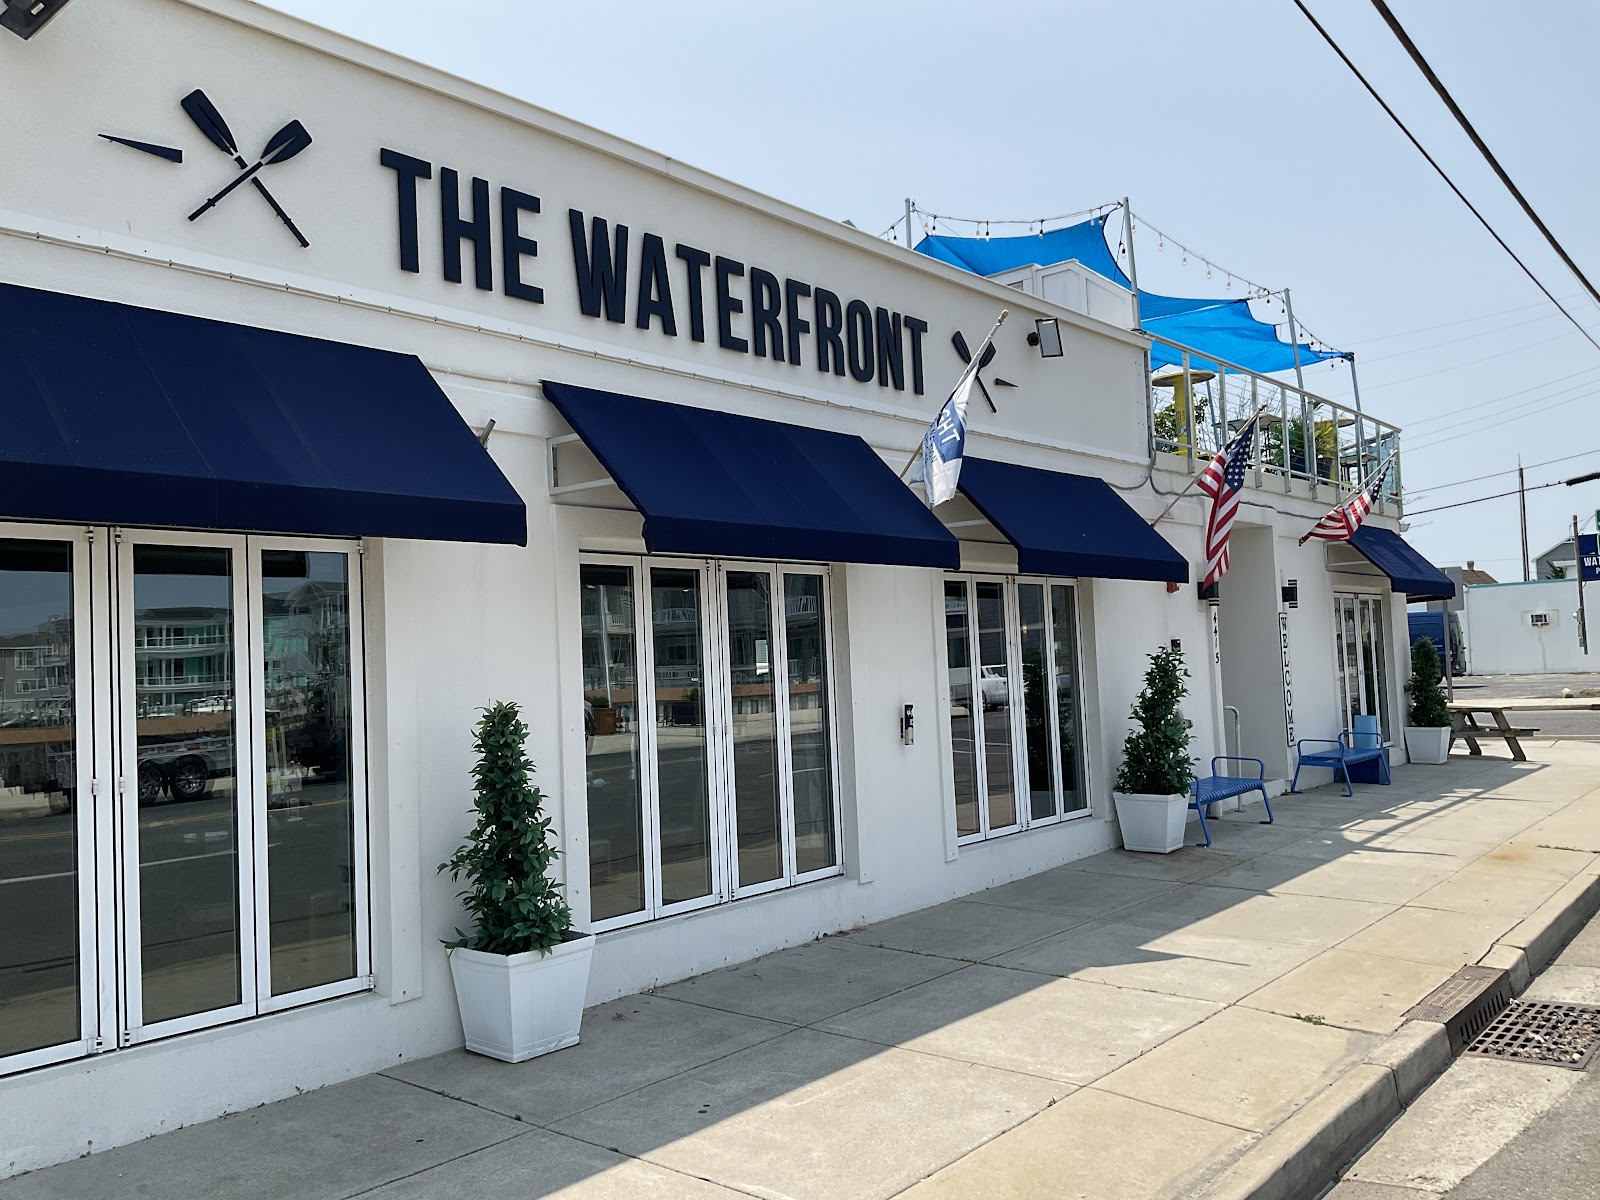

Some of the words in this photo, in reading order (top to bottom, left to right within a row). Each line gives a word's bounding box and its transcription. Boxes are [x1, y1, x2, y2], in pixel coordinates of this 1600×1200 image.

[380, 147, 545, 304] THE
[568, 208, 929, 396] WATERFRONT
[1280, 616, 1295, 743] WELCOME
